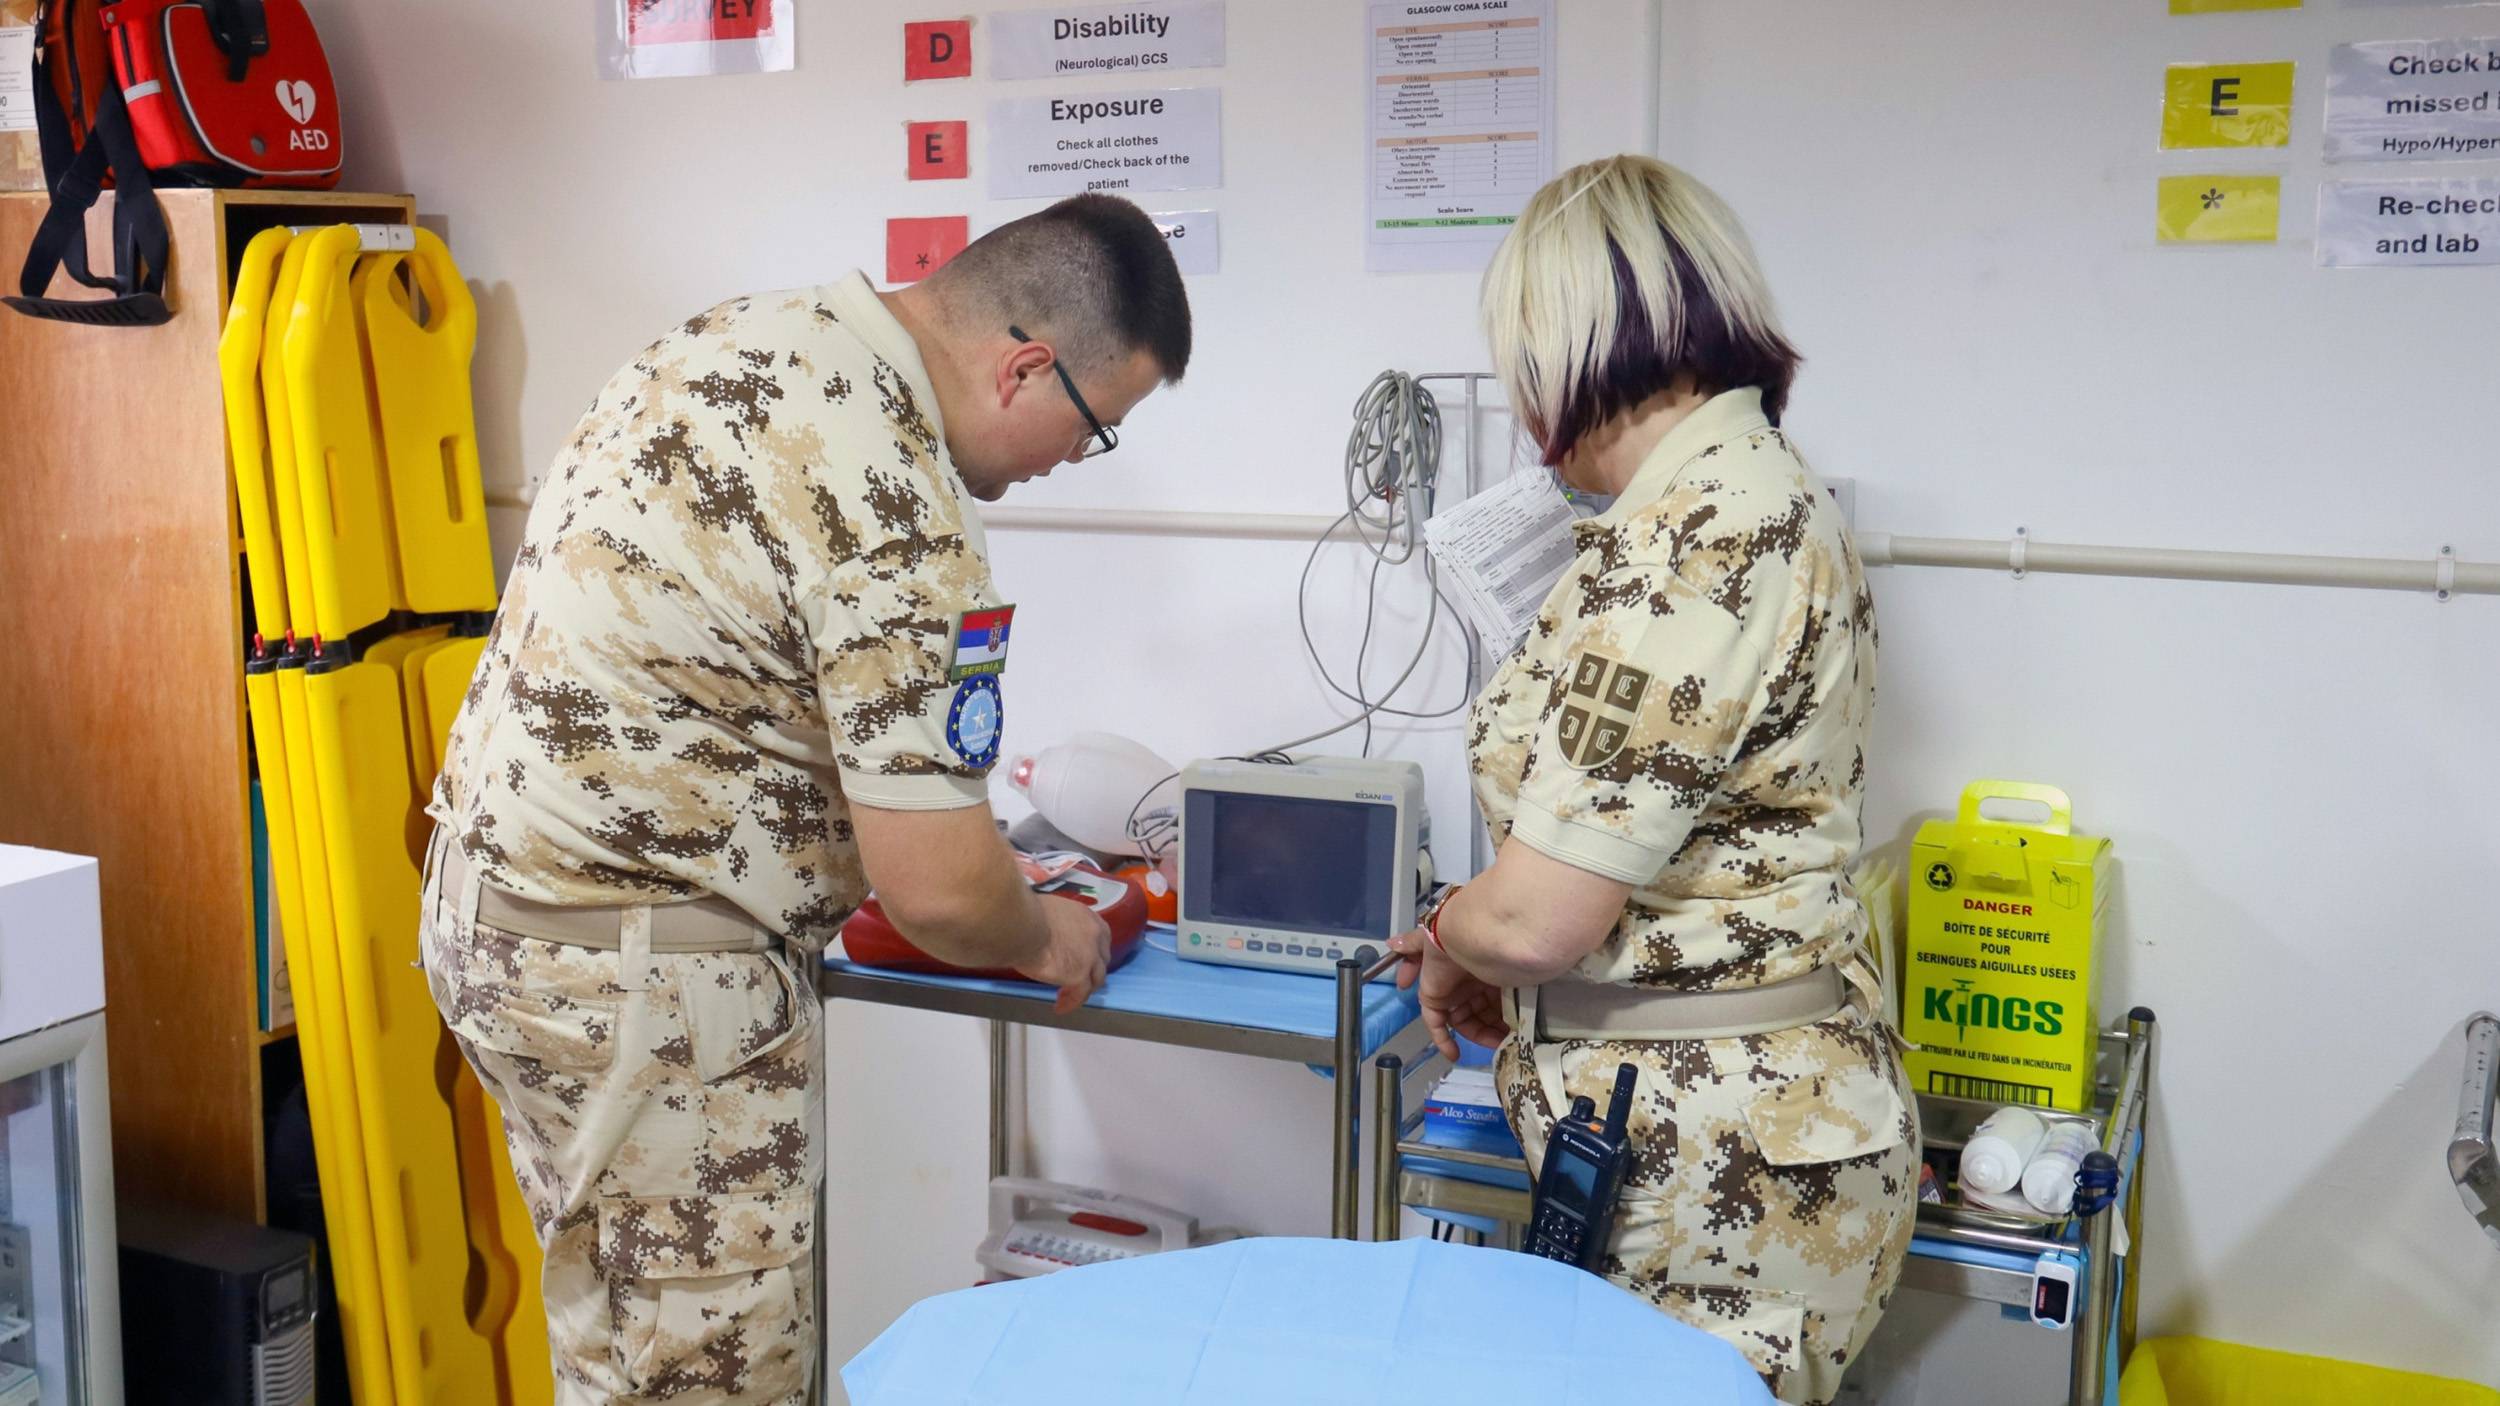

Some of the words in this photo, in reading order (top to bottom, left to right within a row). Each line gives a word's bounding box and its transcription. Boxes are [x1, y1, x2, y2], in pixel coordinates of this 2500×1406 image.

[1406, 5, 1452, 15] GLASGOW
[1453, 3, 1481, 11] COMA
[1482, 1, 1508, 10] SCALE
[1054, 13, 1170, 40] Disability
[930, 32, 953, 63] D
[1056, 54, 1139, 72] (Neurological)
[1141, 52, 1168, 65] GCS
[2389, 52, 2480, 76] Check
[2211, 78, 2240, 116] E
[2386, 90, 2489, 114] missed
[1051, 97, 1164, 124] Exposure
[290, 129, 329, 151] AED
[925, 133, 943, 163] E
[1057, 138, 1094, 150] Check
[1096, 137, 1111, 149] all
[1114, 135, 1158, 148] clothes
[1028, 157, 1121, 173] removed/Check
[1124, 156, 1152, 168] back
[1155, 154, 1168, 166] of
[1170, 153, 1190, 165] the
[1087, 178, 1129, 191] patient
[2379, 194, 2500, 215] Re-chec
[2375, 233, 2427, 254] and
[2436, 233, 2480, 253] lab
[961, 661, 999, 676] SERBIA
[1963, 898, 2033, 916] DANGER
[1979, 925, 1993, 938] DE
[1980, 942, 2011, 955] POUR
[1916, 951, 1977, 969] SERINGUES
[1980, 959, 2037, 977] AIGUILLES
[1954, 1048, 1967, 1058] PAR
[1968, 1050, 1976, 1059] LE
[1978, 1051, 1990, 1061] FEU
[1992, 1053, 2009, 1064] DANS
[2011, 1056, 2021, 1066] UN
[1440, 1105, 1464, 1119] Alco
